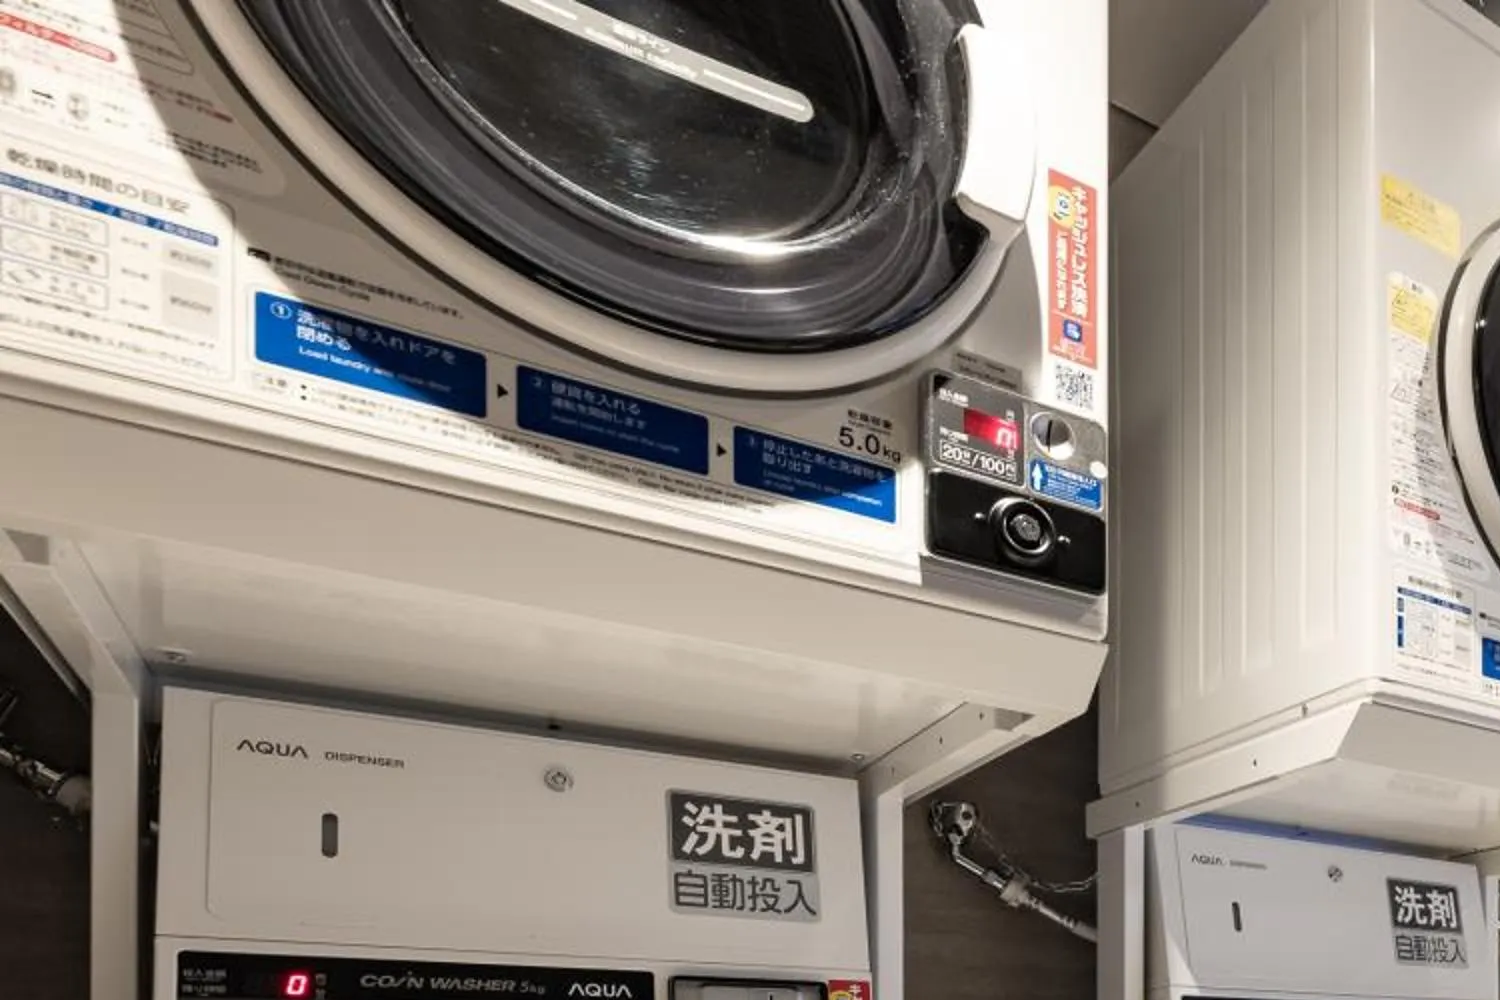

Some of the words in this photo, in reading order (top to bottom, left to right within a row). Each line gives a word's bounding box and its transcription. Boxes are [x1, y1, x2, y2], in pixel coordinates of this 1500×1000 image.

[237, 739, 309, 759] AQUA
[325, 751, 405, 768] DISPENSER
[681, 801, 804, 864] 洗剤
[674, 871, 817, 917] 自動投入
[1395, 886, 1458, 929] 洗剤
[1395, 935, 1467, 963] 自動投入
[285, 975, 308, 996] 0
[430, 976, 516, 992] WASHER
[568, 983, 632, 999] AQUA
